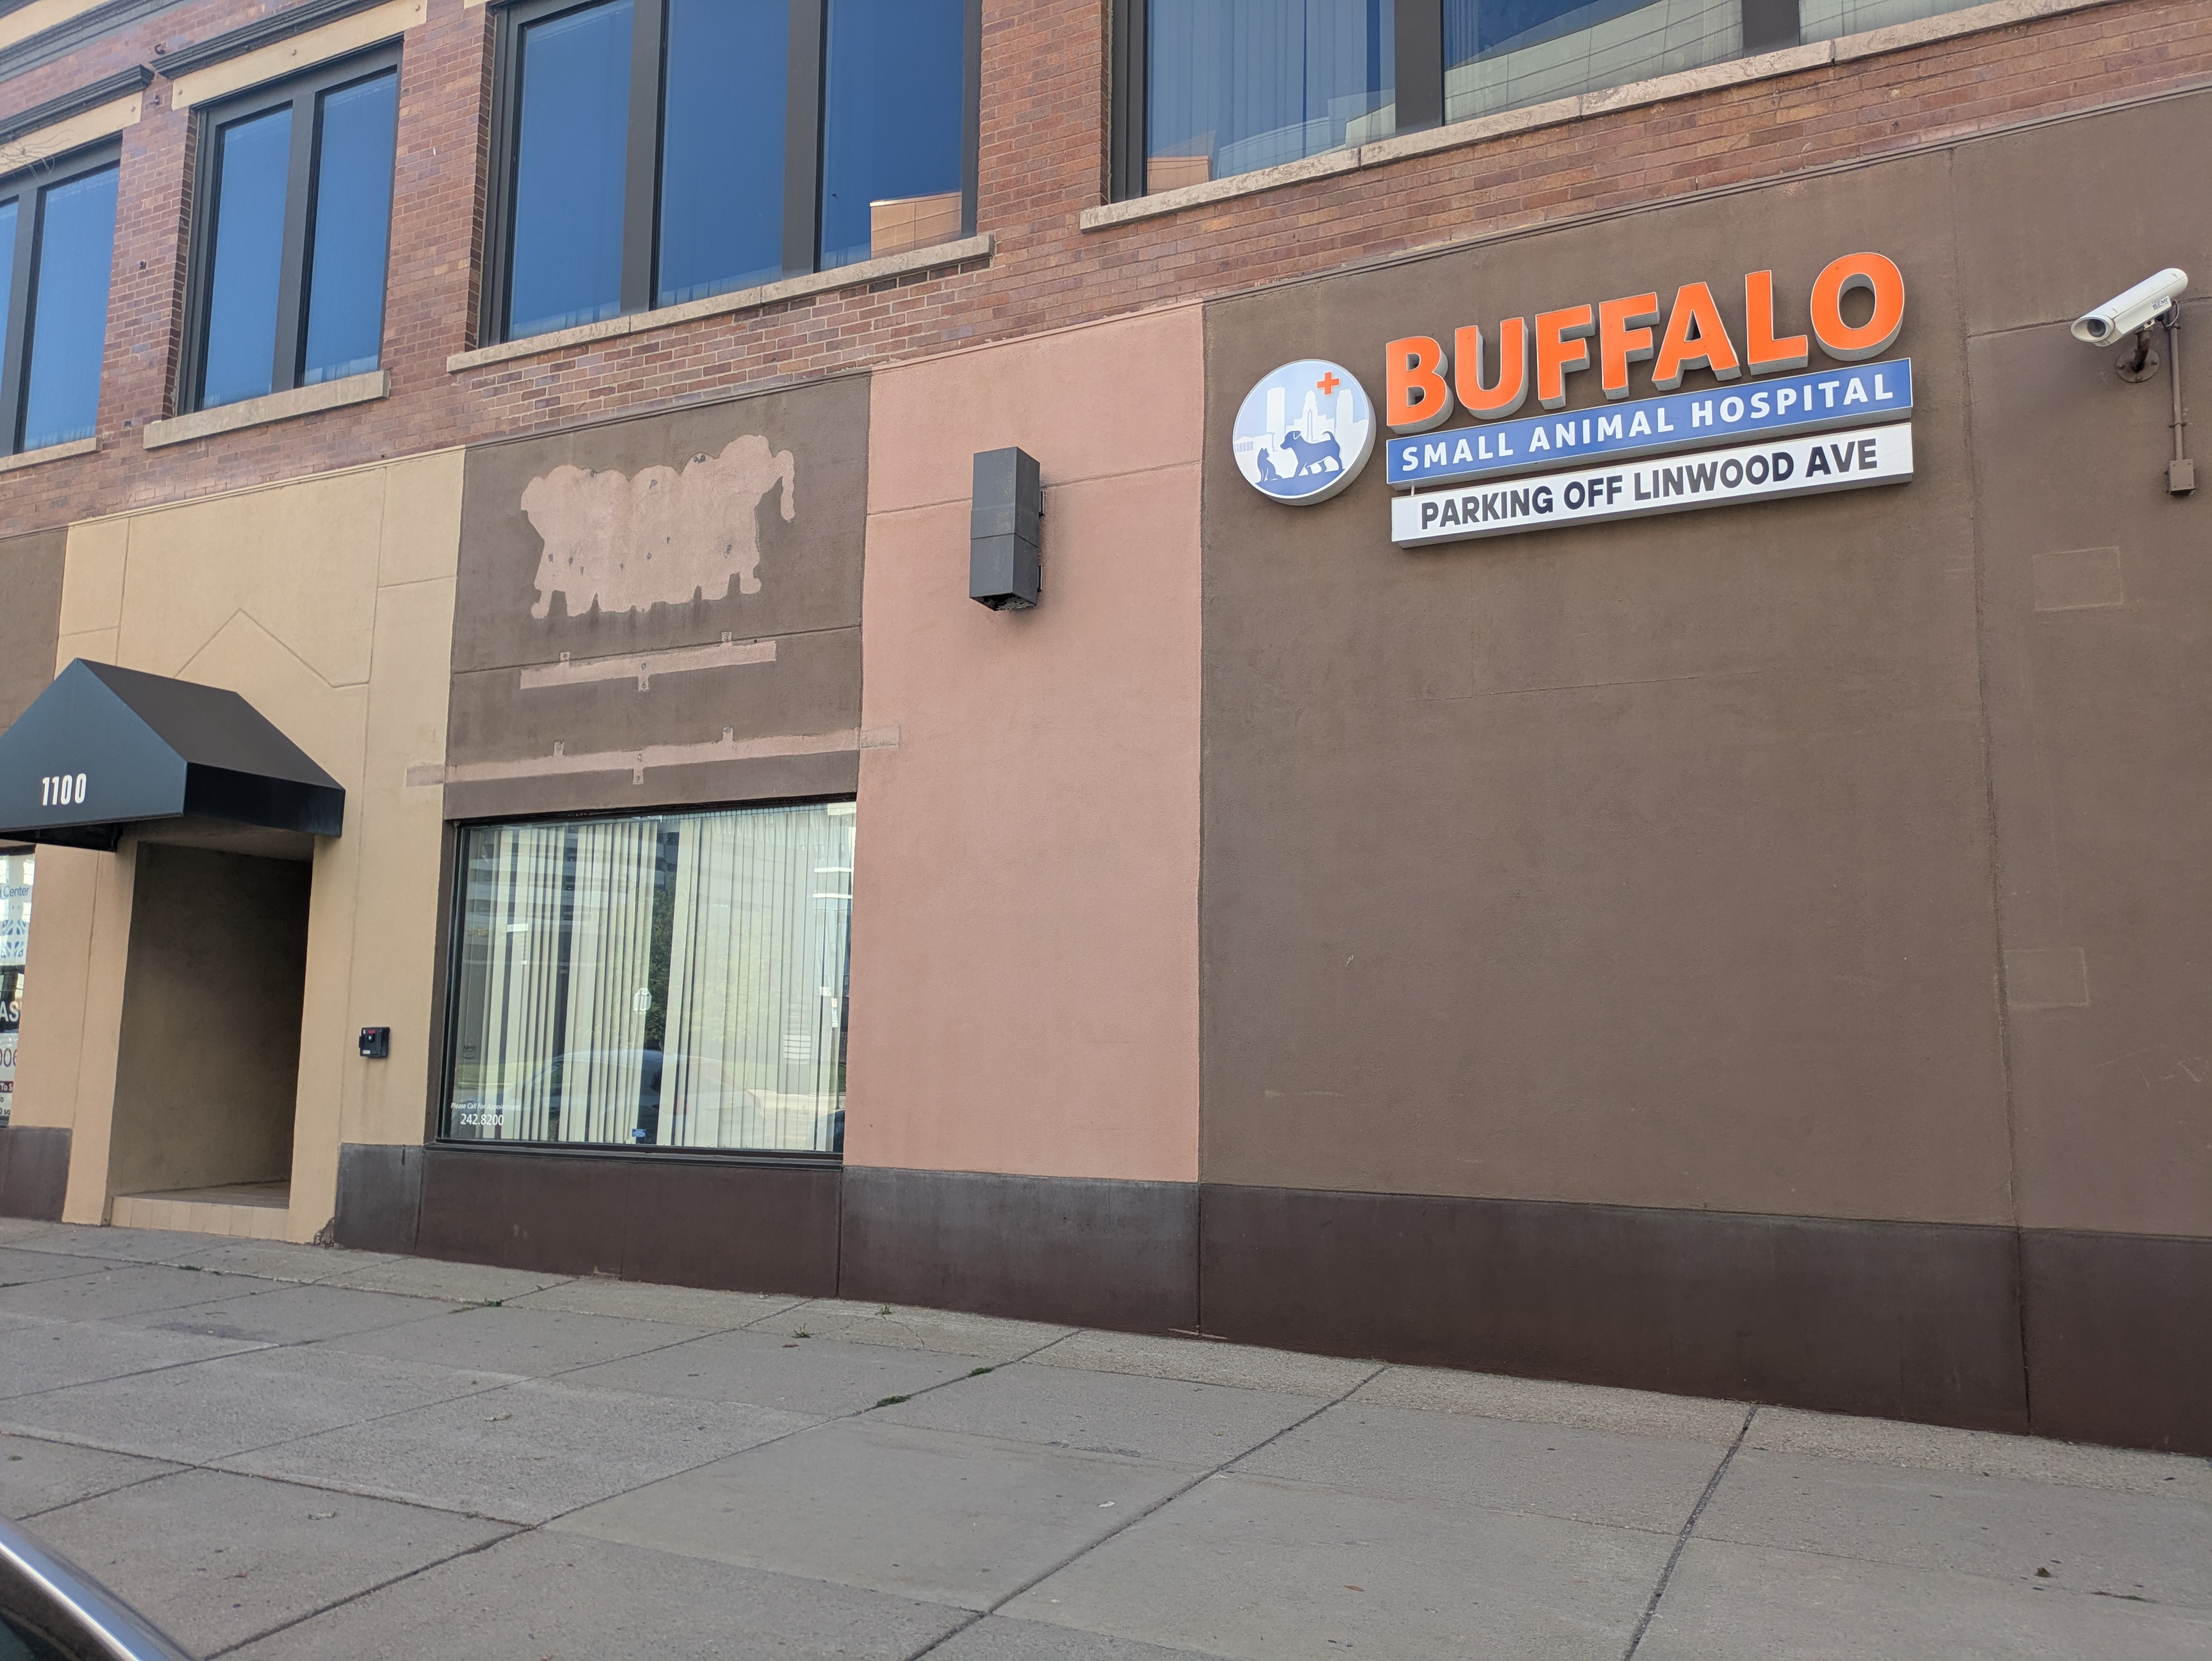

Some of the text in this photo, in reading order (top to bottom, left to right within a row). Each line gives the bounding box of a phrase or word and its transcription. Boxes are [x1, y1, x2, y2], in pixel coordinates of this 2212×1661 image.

[1386, 252, 1904, 428] BUFFALO
[1402, 374, 1893, 472] SMALL ANIMAL HOSPITAL
[1421, 438, 1877, 530] PARKING OFF LINWOOD AVE
[42, 773, 87, 806] 1100
[3, 885, 30, 897] Center
[460, 1113, 504, 1126] 242.8200
